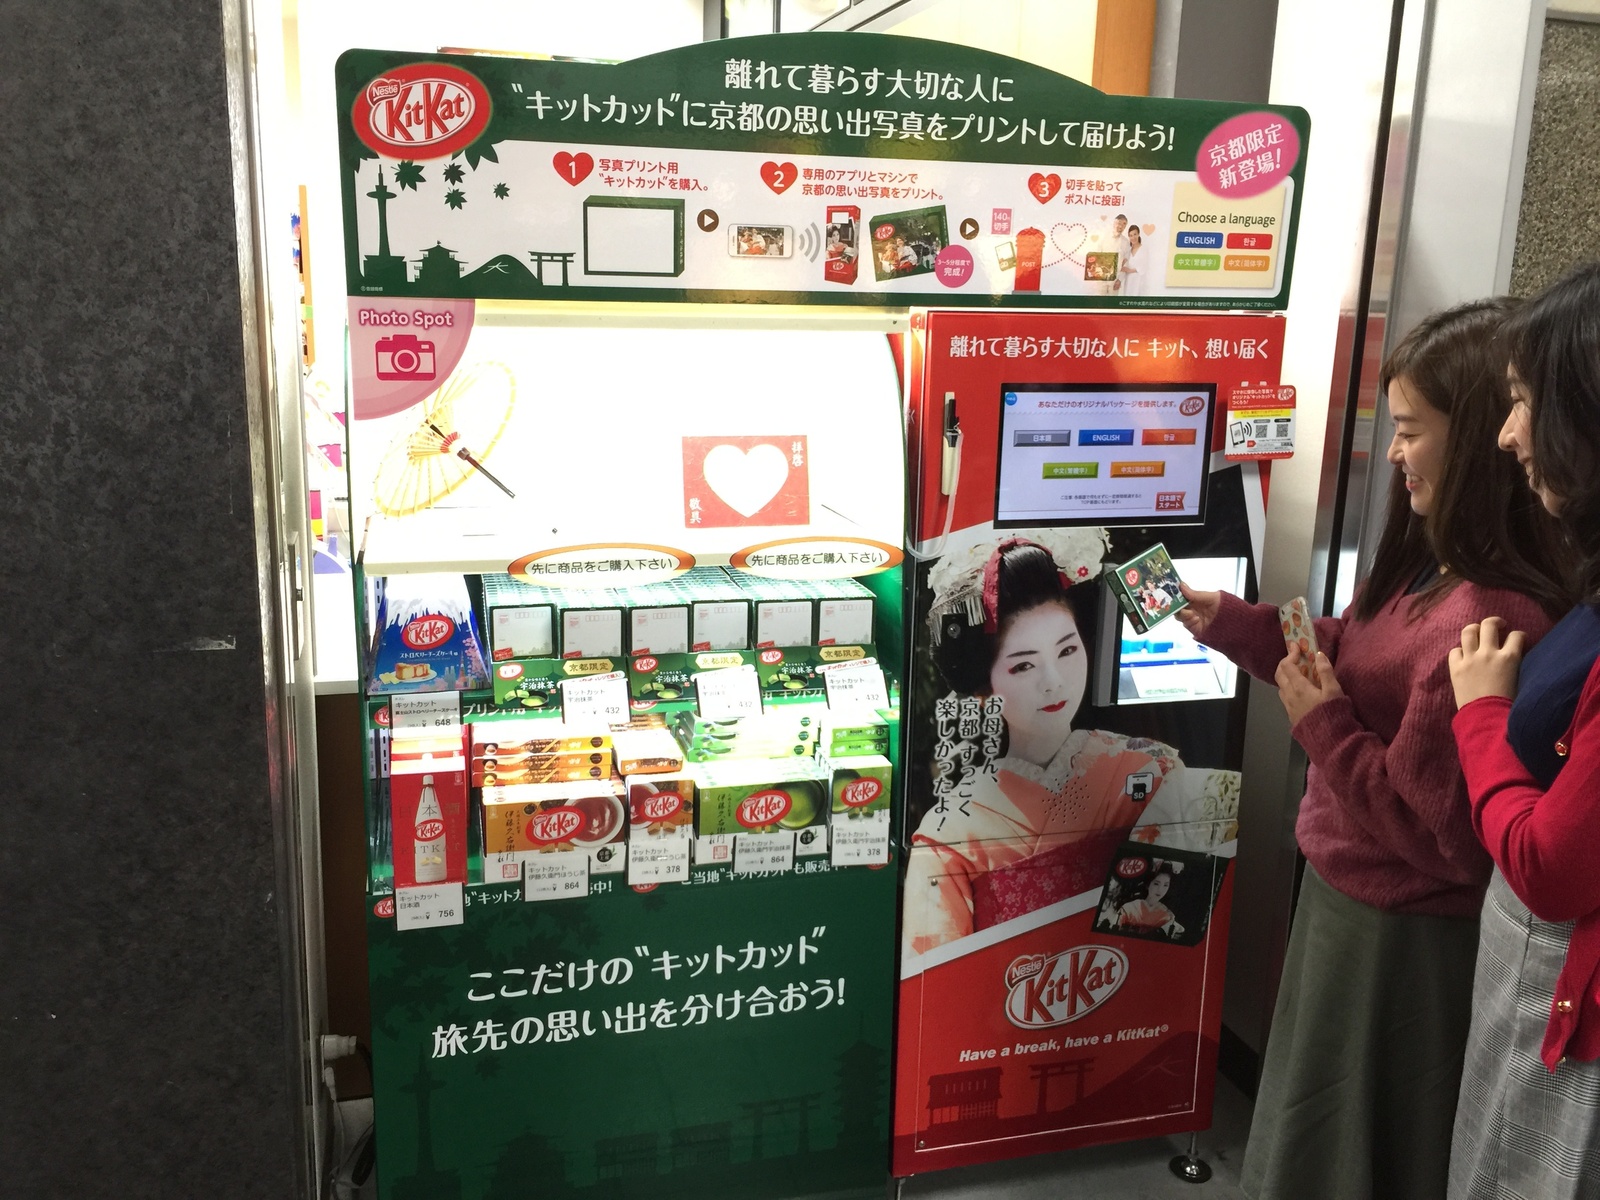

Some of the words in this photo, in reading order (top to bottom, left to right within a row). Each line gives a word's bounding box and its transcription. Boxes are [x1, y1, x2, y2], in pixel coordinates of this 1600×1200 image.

[724, 58, 1015, 103] 離れて暮らす大切な人に
[385, 83, 465, 141] KitKat
[1208, 123, 1285, 168] 京都限定
[568, 161, 577, 179] 1
[598, 158, 679, 175] 写真プリント用
[1218, 148, 1282, 190] 新登場!
[772, 170, 785, 188] 2
[802, 167, 919, 182] 専用のアプリとマシンで
[801, 183, 944, 200] 京都の思い出写真をプリント。
[1038, 181, 1050, 198] 3
[1065, 179, 1123, 192] 切手を貼って
[1064, 194, 1126, 206] ポストに投函!
[993, 222, 1009, 231] 切手
[1177, 211, 1217, 224] Choose
[1219, 215, 1227, 224] a
[1229, 213, 1276, 228] language
[1184, 236, 1216, 245] ENGLISH
[360, 310, 409, 325] Photo
[414, 312, 452, 329] Spot
[949, 336, 1140, 359] 離れて暮らす大切な人に
[1037, 400, 1177, 409] あなただけのオリジナルパッケージを提供します。
[1033, 434, 1052, 442] 日本語
[531, 557, 673, 576] 先に商品をご購入下さい
[750, 552, 884, 567] 先に商品をご購入下さい
[415, 621, 445, 644] KitKat
[824, 649, 861, 657] 京都限定
[569, 660, 610, 672] 京都限定
[781, 666, 814, 675] 宇治抹茶
[655, 673, 689, 683] 宇治抹茶
[519, 681, 556, 691] 宇治抹茶
[395, 700, 437, 708] キットカット
[435, 718, 451, 726] 648
[934, 700, 957, 832] 楽しかったよ!
[1133, 792, 1145, 800] SD
[650, 796, 676, 816] KitKat
[749, 797, 782, 821] KitKat
[540, 813, 576, 839] KitKat
[867, 848, 881, 856] 378
[528, 866, 567, 874] キットカット
[666, 865, 681, 873] 378
[564, 882, 580, 890] 864
[399, 893, 441, 902] キットカット
[400, 902, 421, 910] 日本酒
[438, 909, 455, 918] 756
[1023, 949, 1117, 1023] KitKat
[431, 977, 847, 1059] 旅先の思い出を分け合おう!
[959, 1050, 997, 1062] Have
[1000, 1047, 1010, 1057] a
[1014, 1039, 1060, 1056] break,
[1064, 1035, 1099, 1049] have
[1103, 1033, 1112, 1044] a
